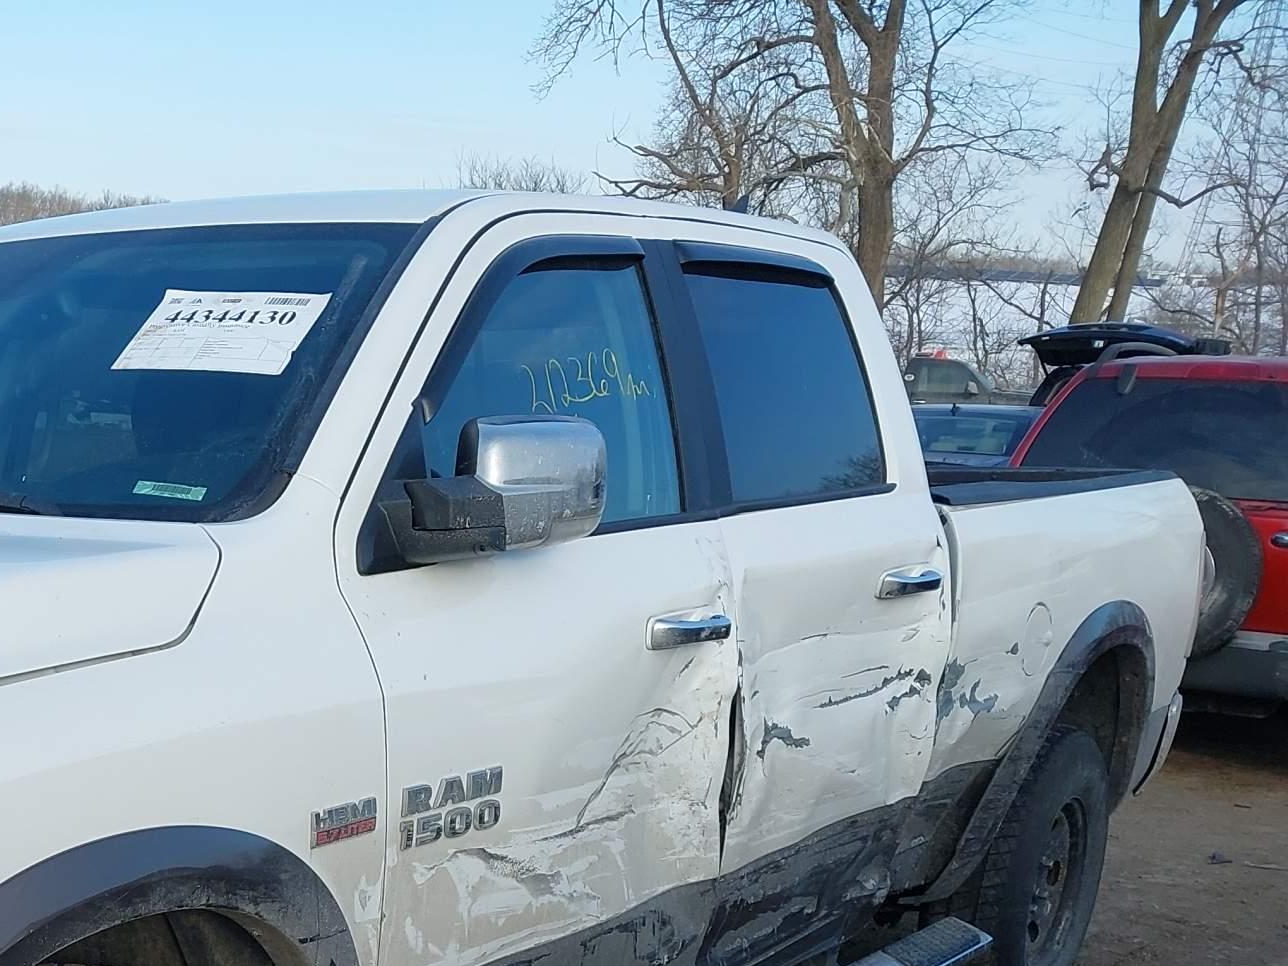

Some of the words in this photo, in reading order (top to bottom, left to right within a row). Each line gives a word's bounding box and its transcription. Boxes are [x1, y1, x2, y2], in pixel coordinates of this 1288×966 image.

[164, 309, 297, 326] 44344130
[401, 765, 503, 818] RAM
[311, 796, 377, 832] HEMI
[399, 799, 501, 850] 1500
